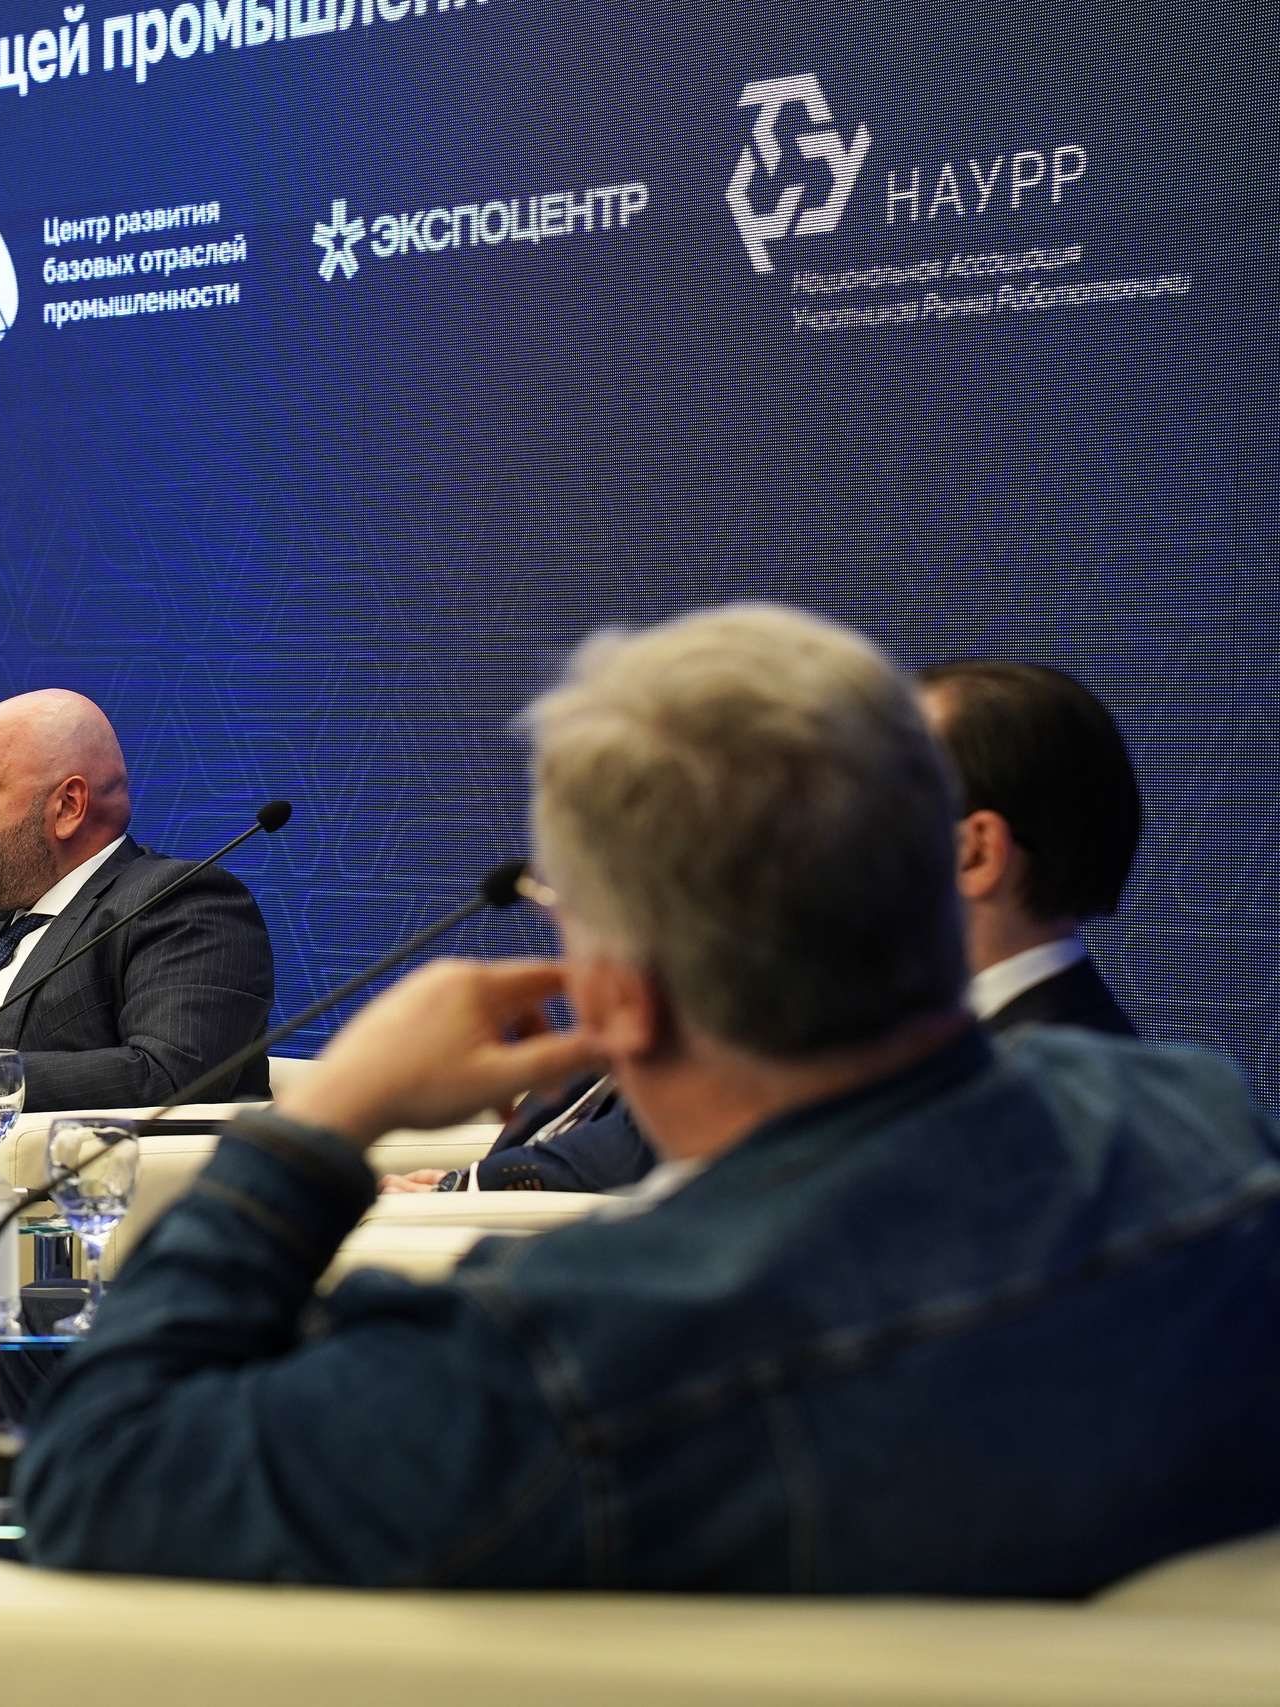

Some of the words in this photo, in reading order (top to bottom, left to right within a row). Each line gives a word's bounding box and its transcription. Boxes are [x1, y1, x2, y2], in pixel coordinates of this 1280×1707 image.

[885, 144, 1090, 225] НАУРР
[43, 216, 111, 246] Центр
[114, 201, 220, 242] развития
[370, 181, 650, 258] ЭКСПОЦЕНТР
[43, 252, 135, 285] базовых
[138, 234, 248, 277] отраслей
[43, 283, 240, 330] промышленности
